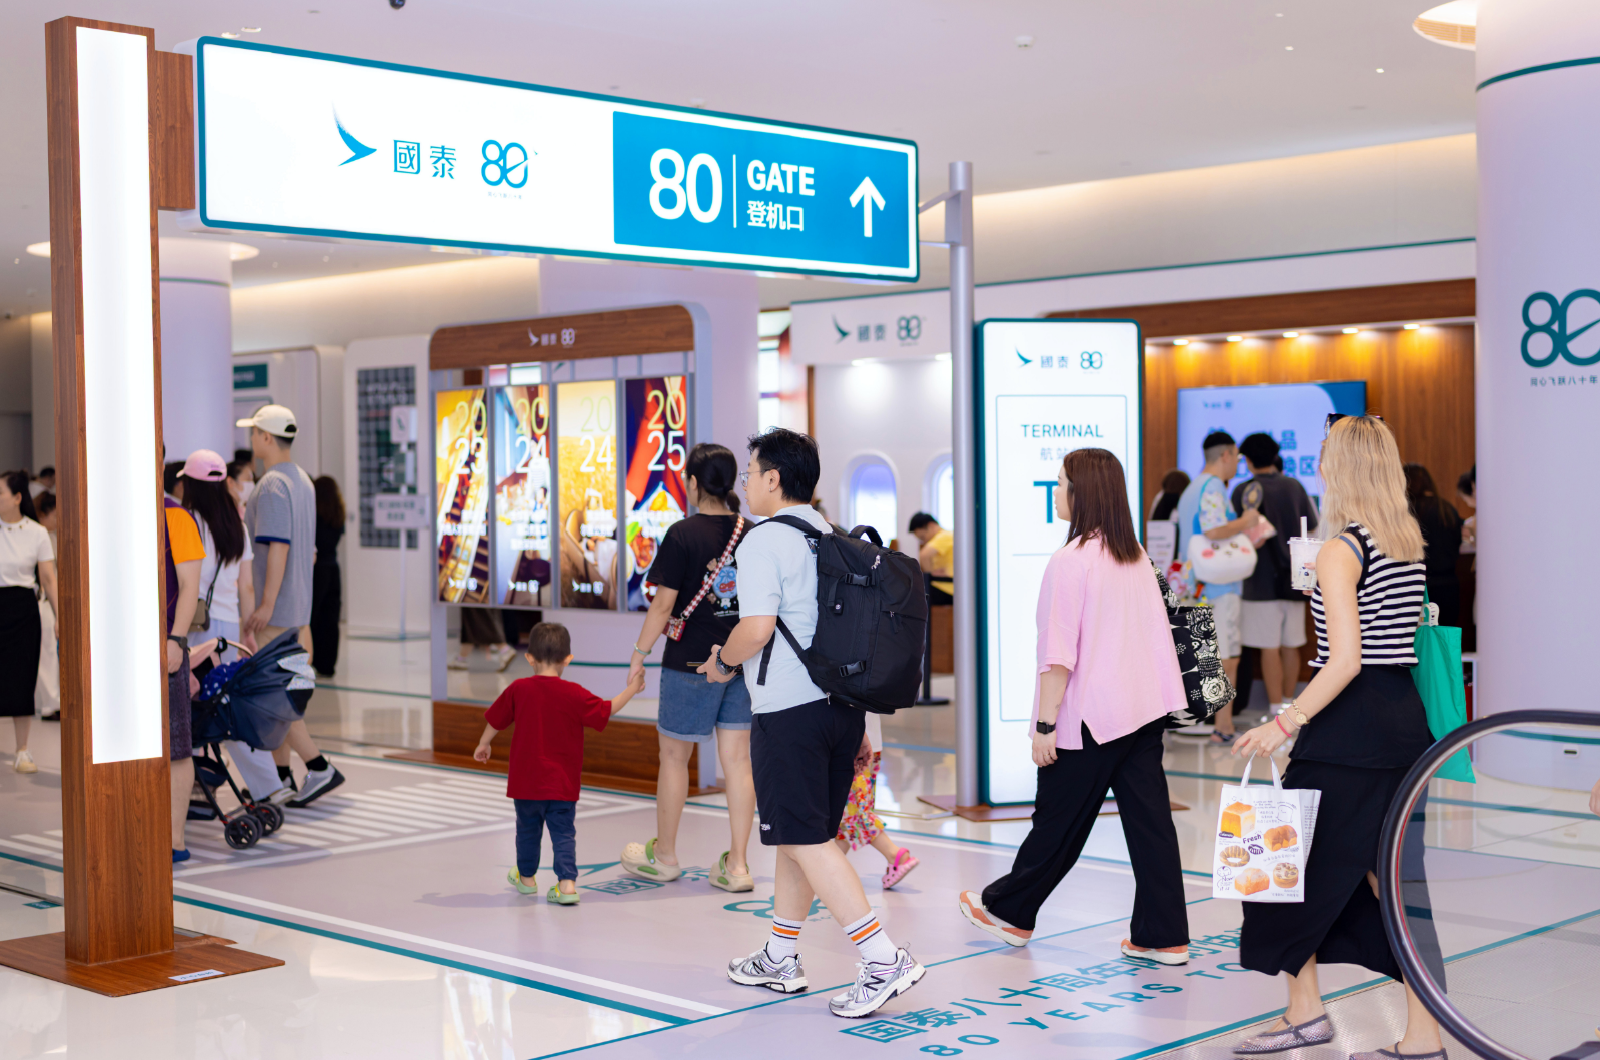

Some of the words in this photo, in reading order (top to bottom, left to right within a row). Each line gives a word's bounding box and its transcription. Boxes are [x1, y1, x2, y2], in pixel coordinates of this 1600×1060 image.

[393, 139, 457, 180] 國泰
[481, 139, 529, 188] 80
[649, 148, 723, 223] 80
[747, 159, 816, 197] GATE
[747, 200, 805, 232] 登机口
[897, 315, 922, 340] 80
[1080, 350, 1103, 370] 80
[455, 401, 487, 437] 20
[516, 397, 549, 435] 20
[580, 396, 613, 433] 20
[647, 390, 686, 430] 20
[1020, 424, 1104, 438] TERMINAL
[455, 437, 487, 475] 23
[515, 435, 548, 474] 24
[579, 434, 614, 472] 24
[647, 431, 686, 471] 25
[1040, 447, 1079, 460] 航站
[1242, 833, 1262, 844] Fresh
[919, 1034, 1000, 1057] 80
[1007, 983, 1184, 1031] YEARS
